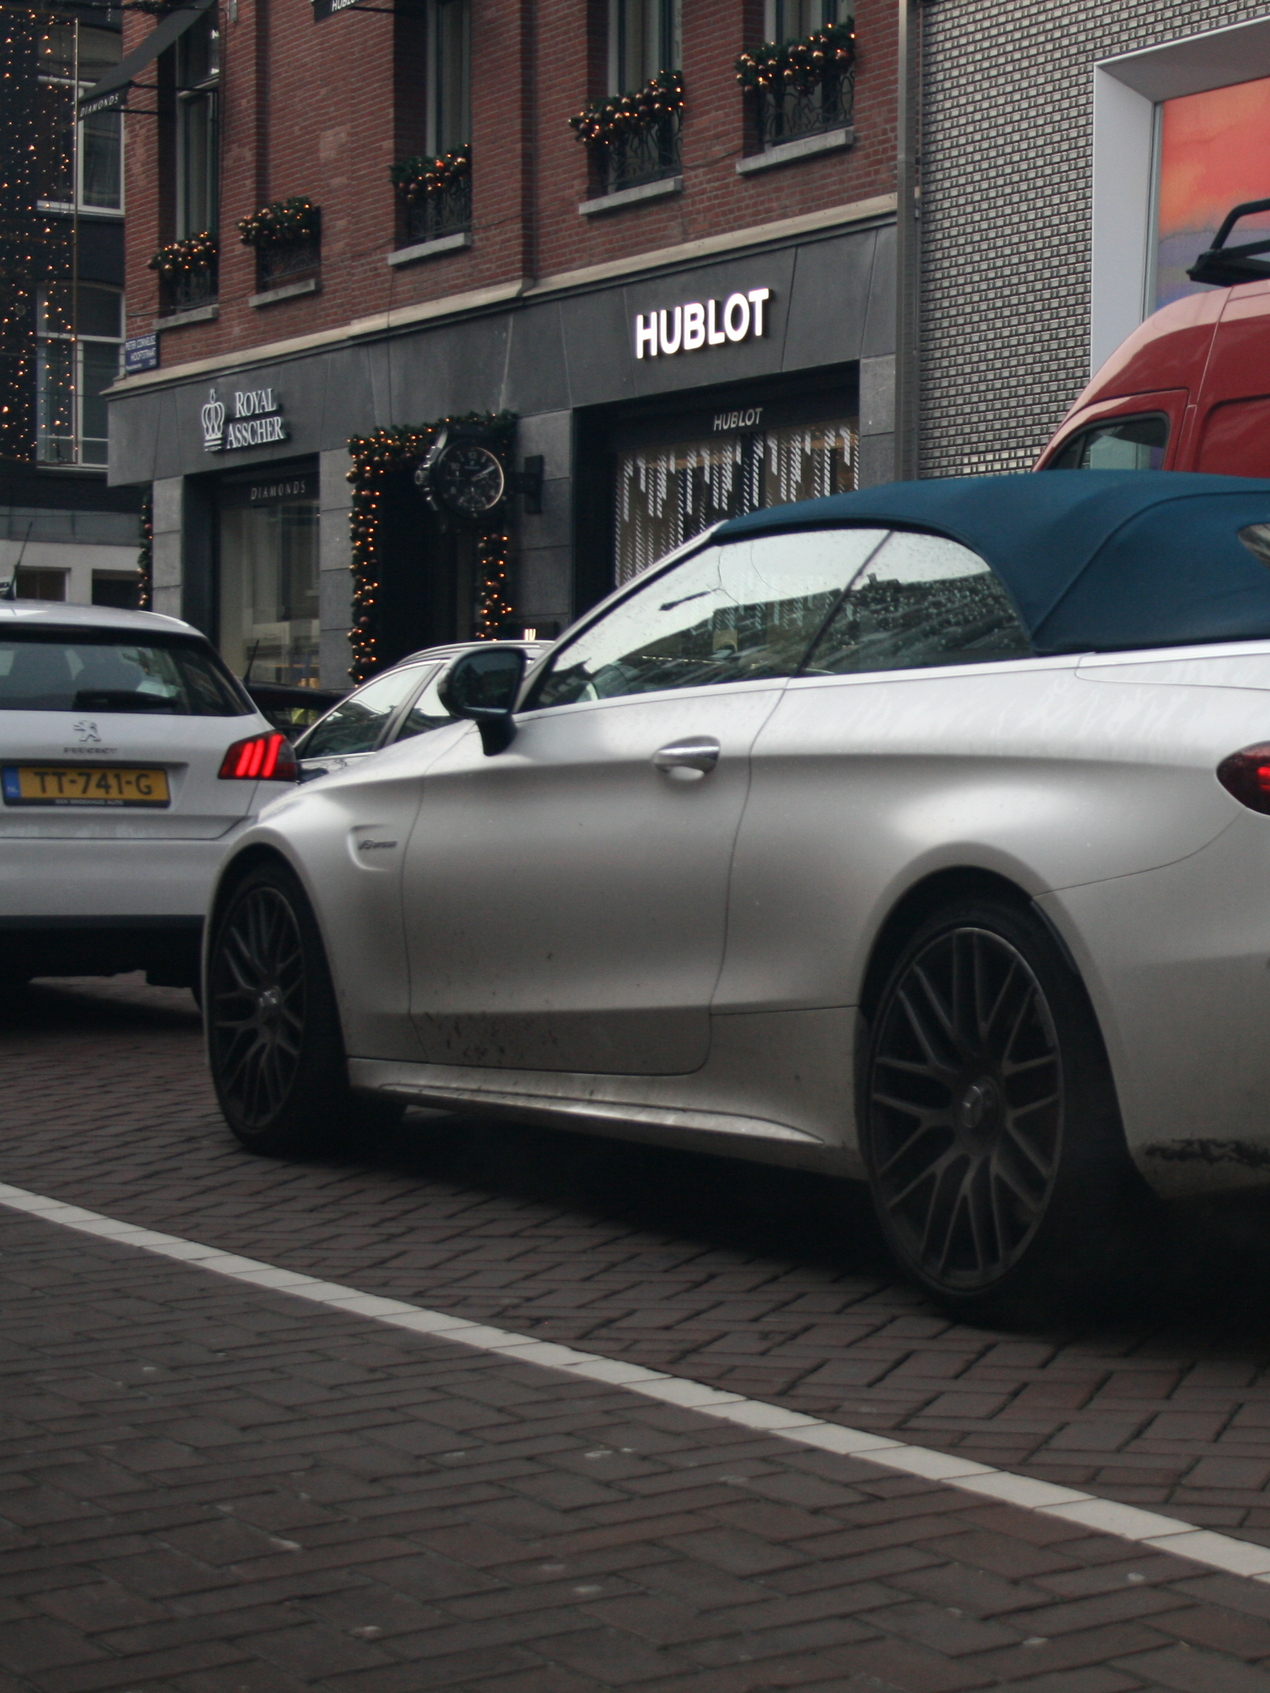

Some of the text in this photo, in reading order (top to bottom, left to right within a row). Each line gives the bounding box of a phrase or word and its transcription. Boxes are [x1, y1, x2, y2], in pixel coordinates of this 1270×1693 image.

[80, 93, 119, 117] DIAMONDS
[636, 287, 770, 360] HUBLOT
[235, 388, 277, 418] ROYAL
[713, 407, 763, 431] HUBLOT
[226, 416, 285, 450] ASSCHER
[251, 480, 306, 500] DIAMONDS
[34, 771, 153, 796] TT-741-G
